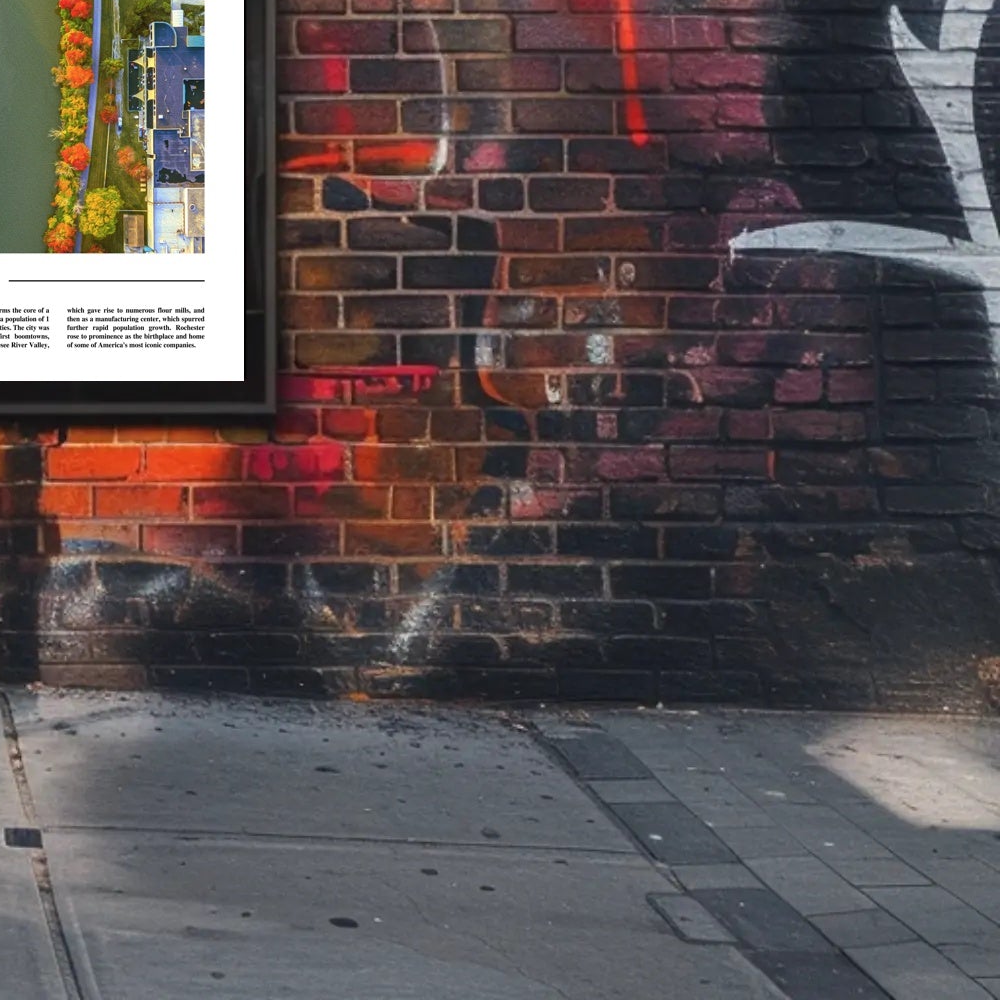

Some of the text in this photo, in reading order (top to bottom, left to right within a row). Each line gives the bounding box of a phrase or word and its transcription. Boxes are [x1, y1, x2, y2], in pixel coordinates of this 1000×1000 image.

[4, 315, 37, 324] population
[37, 315, 45, 323] of
[66, 315, 81, 323] then
[94, 315, 140, 323] manufacturing
[161, 315, 181, 323] which
[181, 315, 205, 324] spurred
[25, 324, 37, 333] city
[92, 324, 109, 333] rapid
[112, 324, 145, 333] population
[88, 333, 124, 341] prominence
[143, 333, 175, 341] birthplace
[11, 341, 28, 349] River
[66, 341, 74, 349] of
[90, 341, 98, 349] of
[144, 341, 163, 349] iconic
